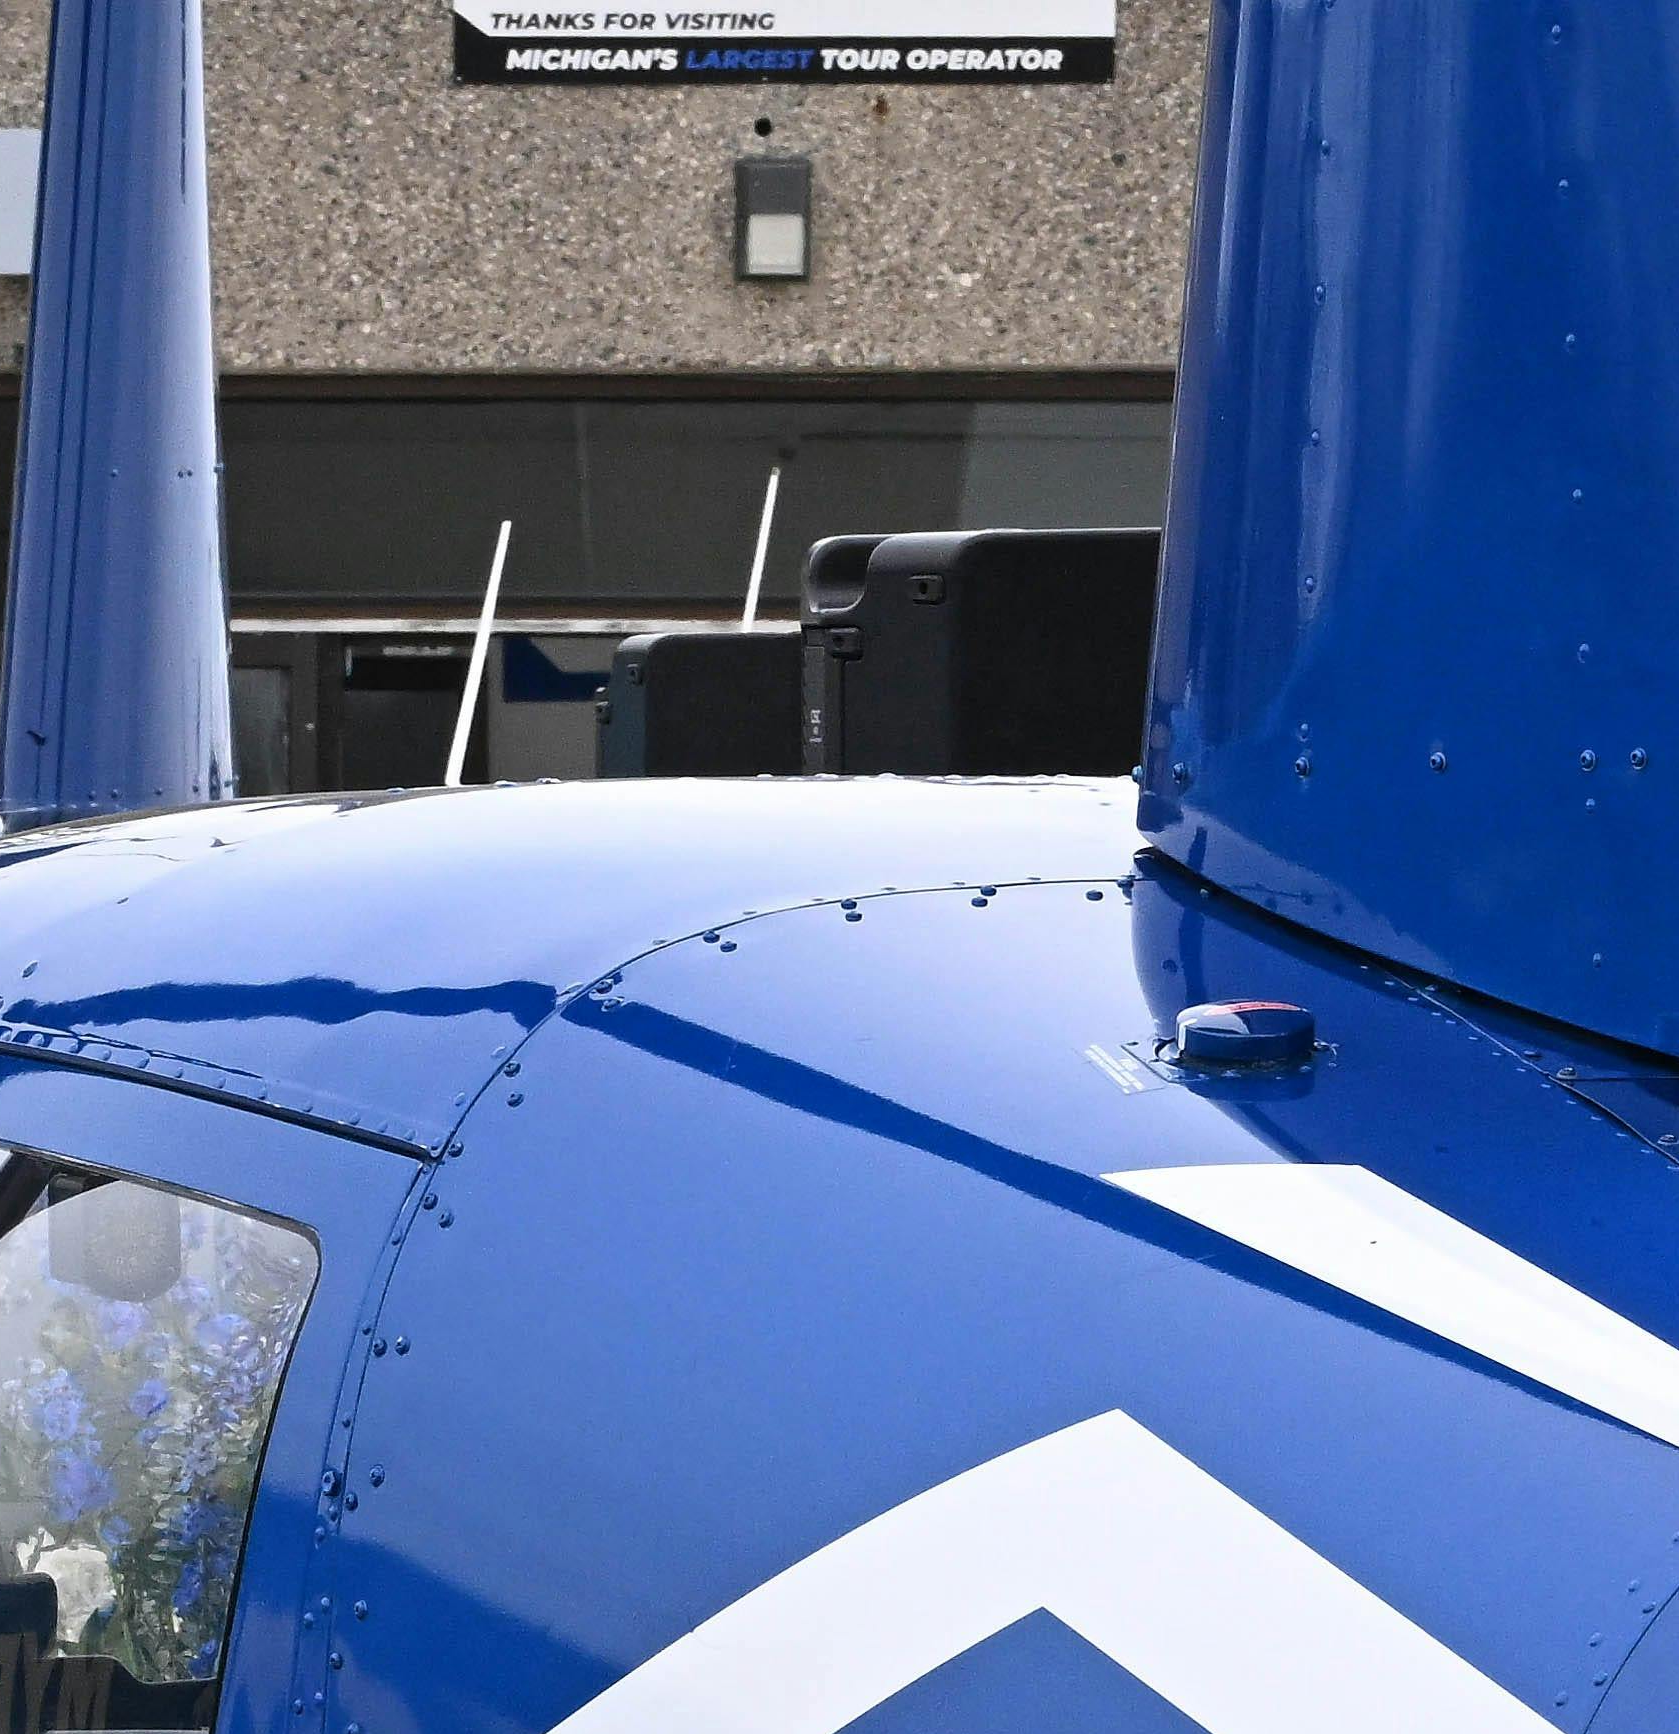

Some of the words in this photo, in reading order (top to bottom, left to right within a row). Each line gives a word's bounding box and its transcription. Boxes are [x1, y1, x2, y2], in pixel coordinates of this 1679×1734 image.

[491, 12, 595, 31] THANKS
[602, 12, 657, 31] FOR
[664, 12, 776, 31] VISITING
[505, 48, 679, 72] MICHIGAN'S
[685, 48, 815, 71] LARGEST
[821, 48, 901, 71] TOUR
[905, 48, 1065, 71] OPERATOR
